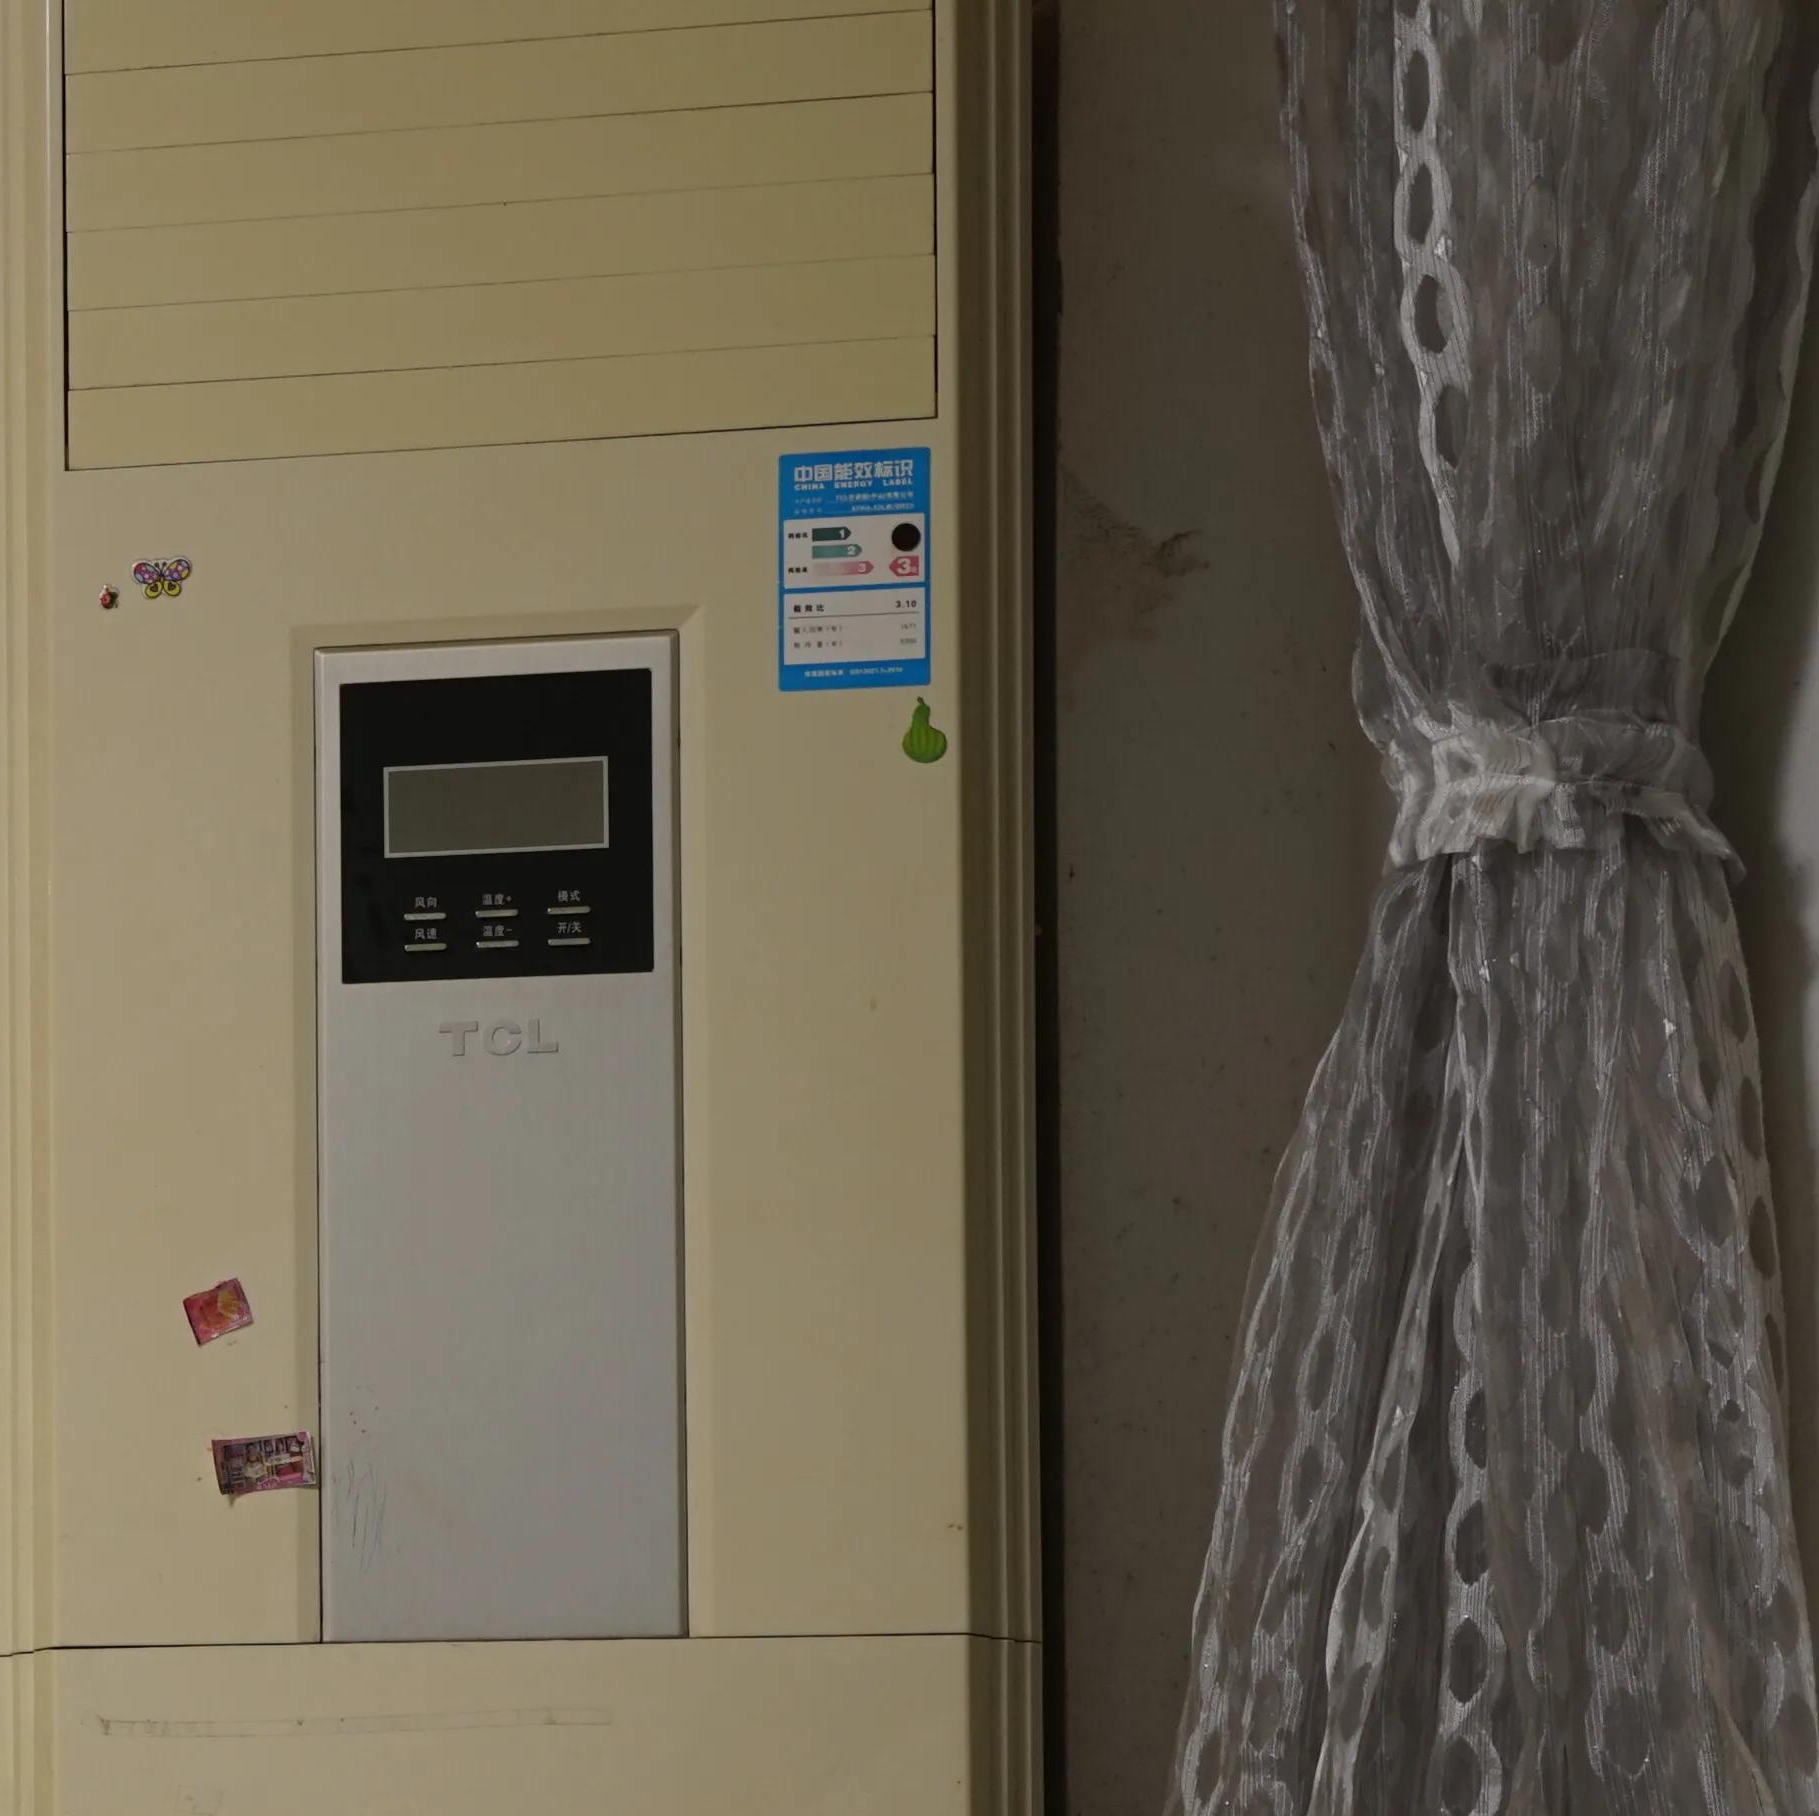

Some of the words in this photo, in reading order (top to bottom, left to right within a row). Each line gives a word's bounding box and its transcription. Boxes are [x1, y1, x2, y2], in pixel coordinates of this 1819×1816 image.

[794, 459, 913, 483] 中国能效标识
[794, 482, 825, 491] CHINA
[834, 480, 873, 489] ENERGY
[883, 478, 912, 487] LABEL
[838, 529, 846, 539] 1
[847, 546, 856, 556] 2
[858, 563, 866, 573] 3
[895, 600, 917, 609] 3.10
[557, 890, 581, 902] 模式
[414, 896, 438, 909] 风向
[557, 921, 582, 934] 开/关
[438, 1018, 559, 1057] TCL
